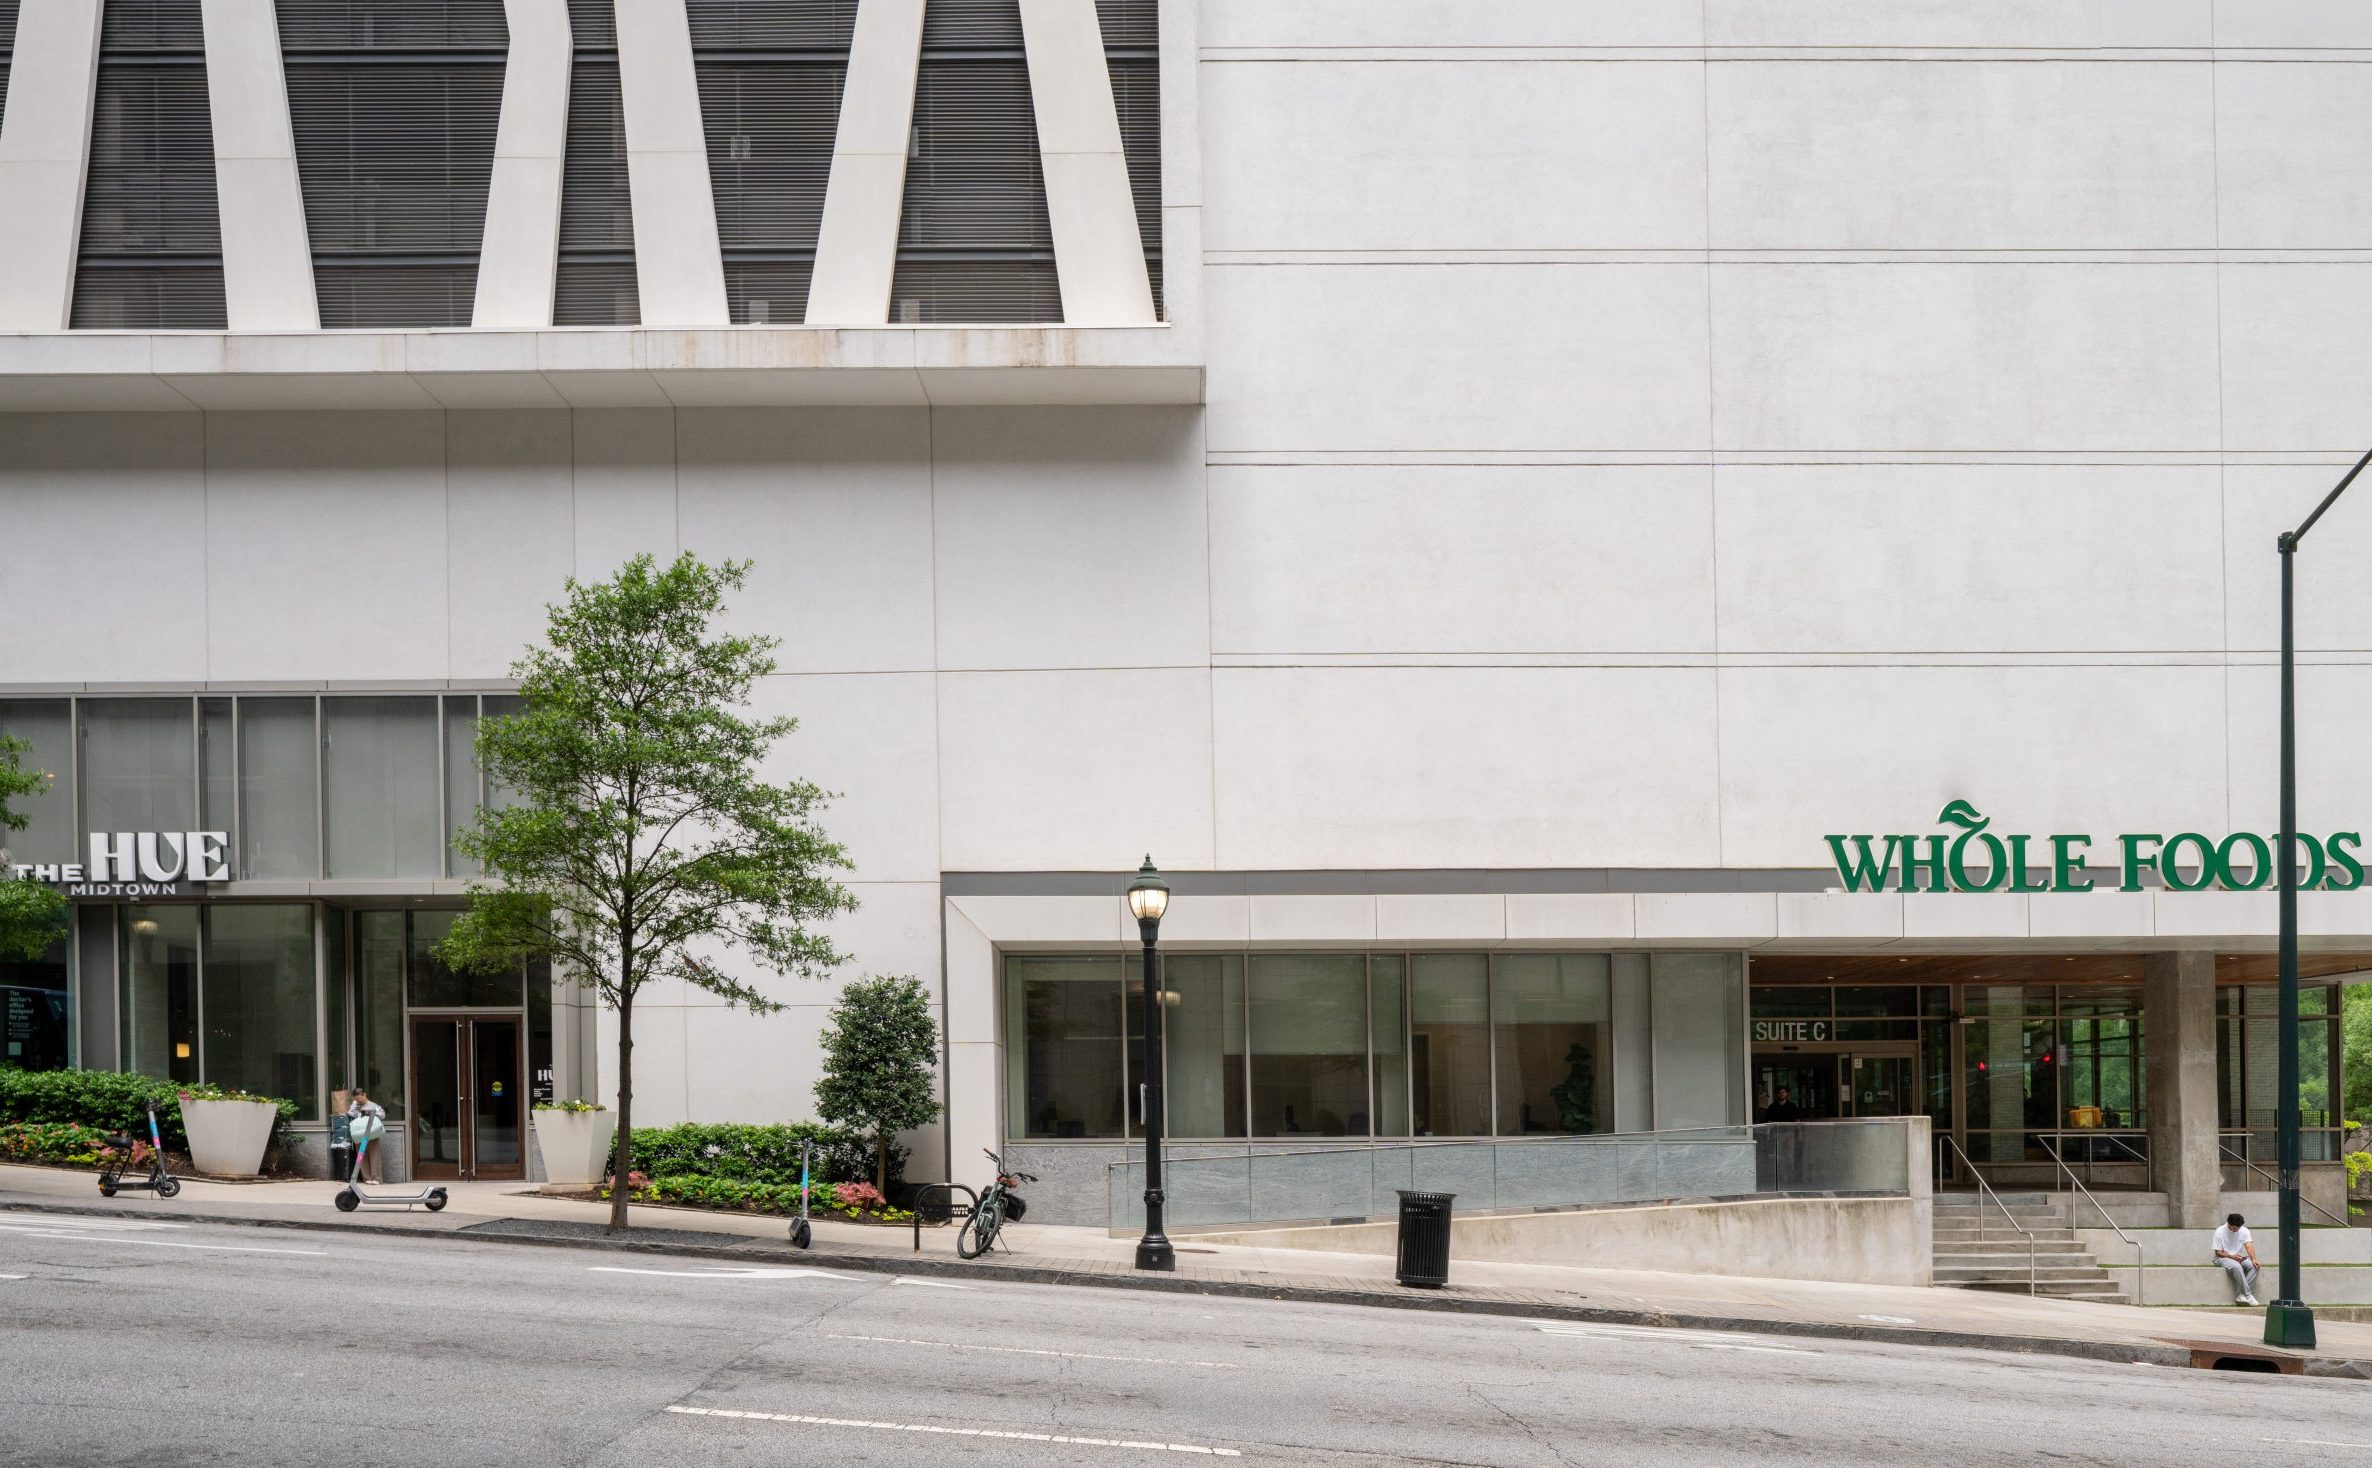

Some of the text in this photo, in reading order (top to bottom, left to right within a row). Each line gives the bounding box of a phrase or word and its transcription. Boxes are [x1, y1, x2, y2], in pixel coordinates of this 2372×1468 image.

[15, 831, 229, 882] THE HUE
[1823, 814, 2365, 893] WHOLE FOODS
[71, 883, 176, 896] MIDTOWN
[1755, 1022, 1826, 1041] SUITE C
